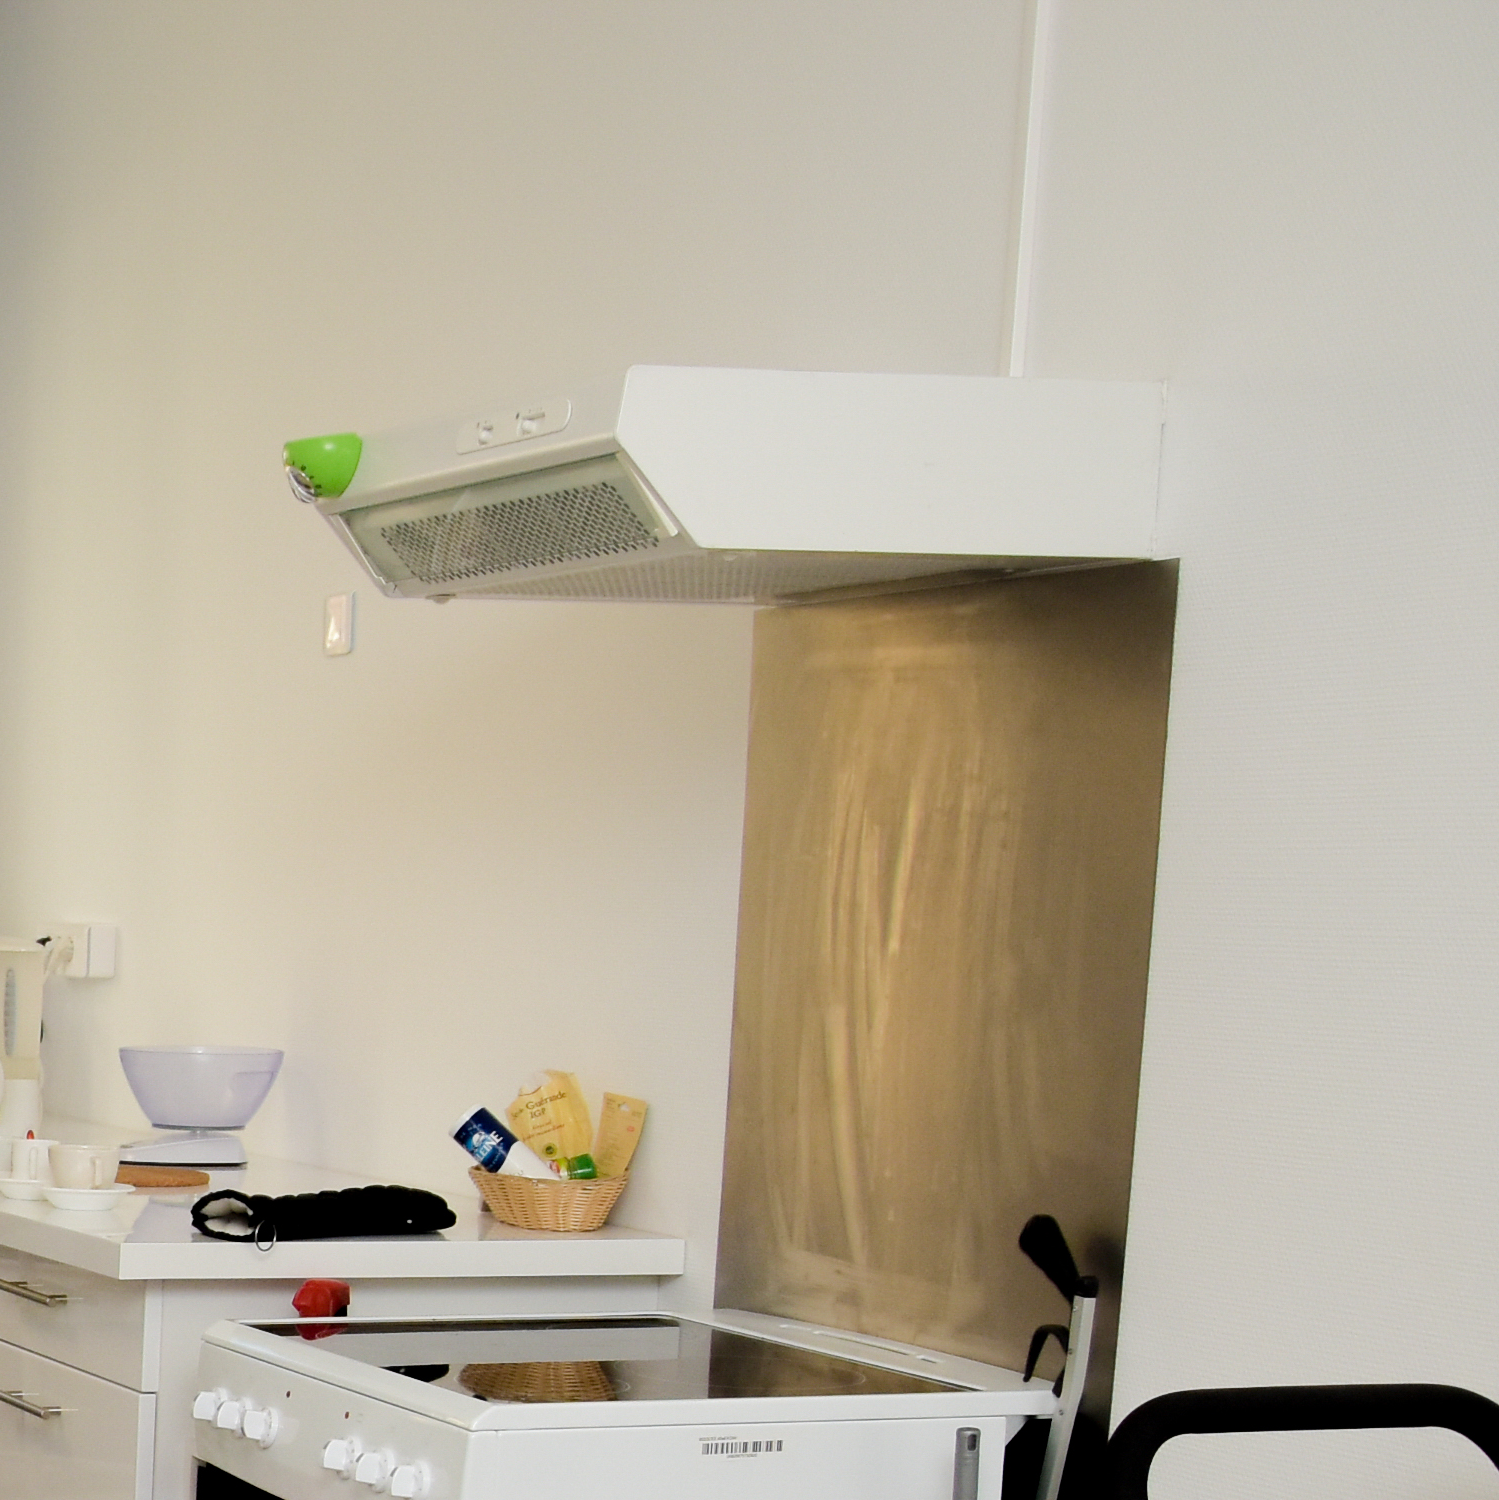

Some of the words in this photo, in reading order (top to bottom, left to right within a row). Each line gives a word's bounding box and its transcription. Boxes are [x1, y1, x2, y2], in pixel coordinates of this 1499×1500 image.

[525, 1090, 567, 1110] Guérande
[530, 1107, 546, 1119] IGP
[474, 1130, 504, 1162] LEINE
